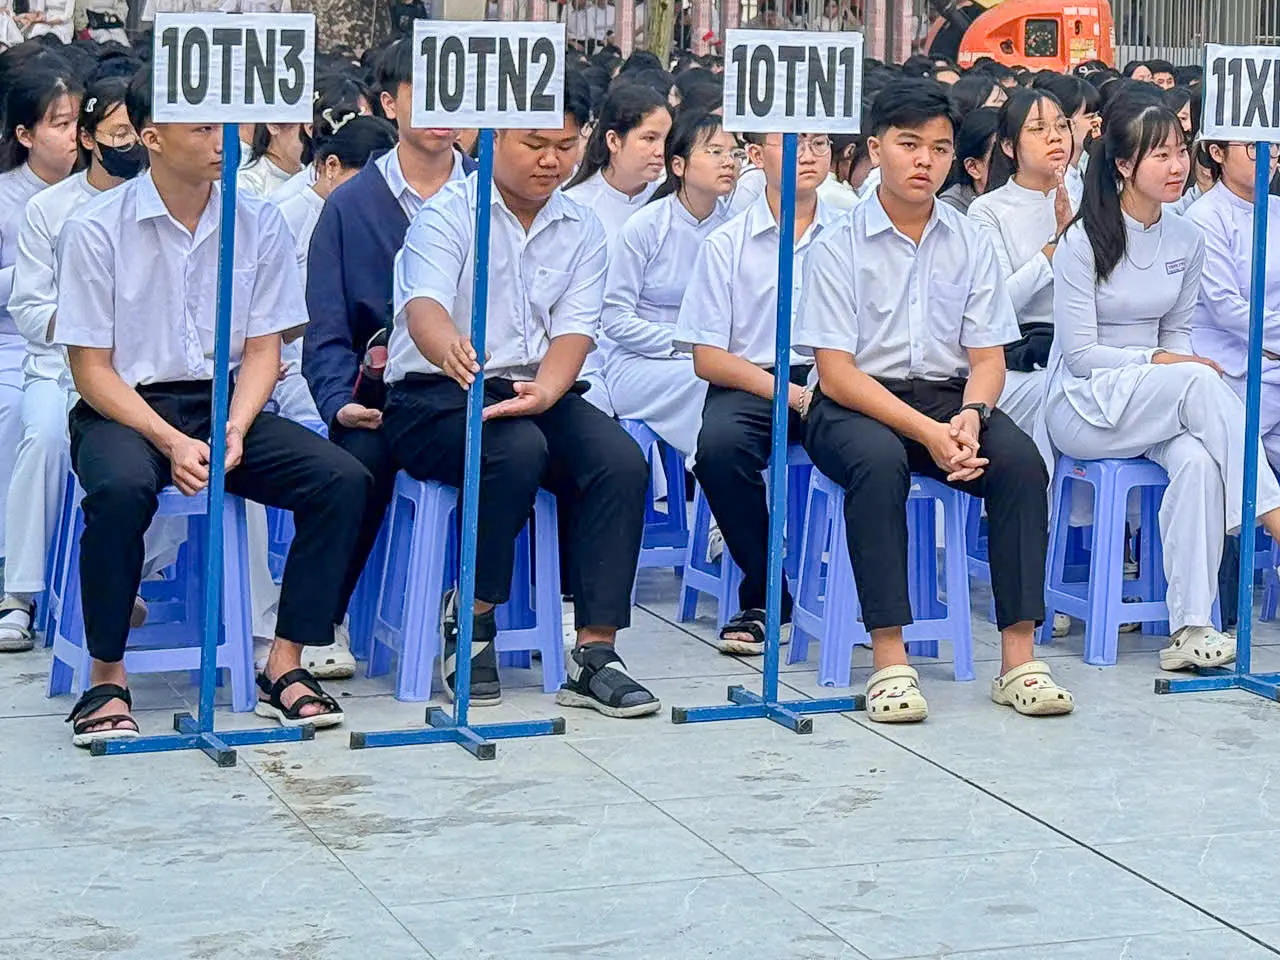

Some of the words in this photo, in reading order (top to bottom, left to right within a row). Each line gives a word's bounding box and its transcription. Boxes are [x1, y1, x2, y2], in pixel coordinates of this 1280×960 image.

[162, 27, 306, 105] 10TN3
[420, 36, 556, 112] 10TN2
[732, 45, 854, 118] 10TN1
